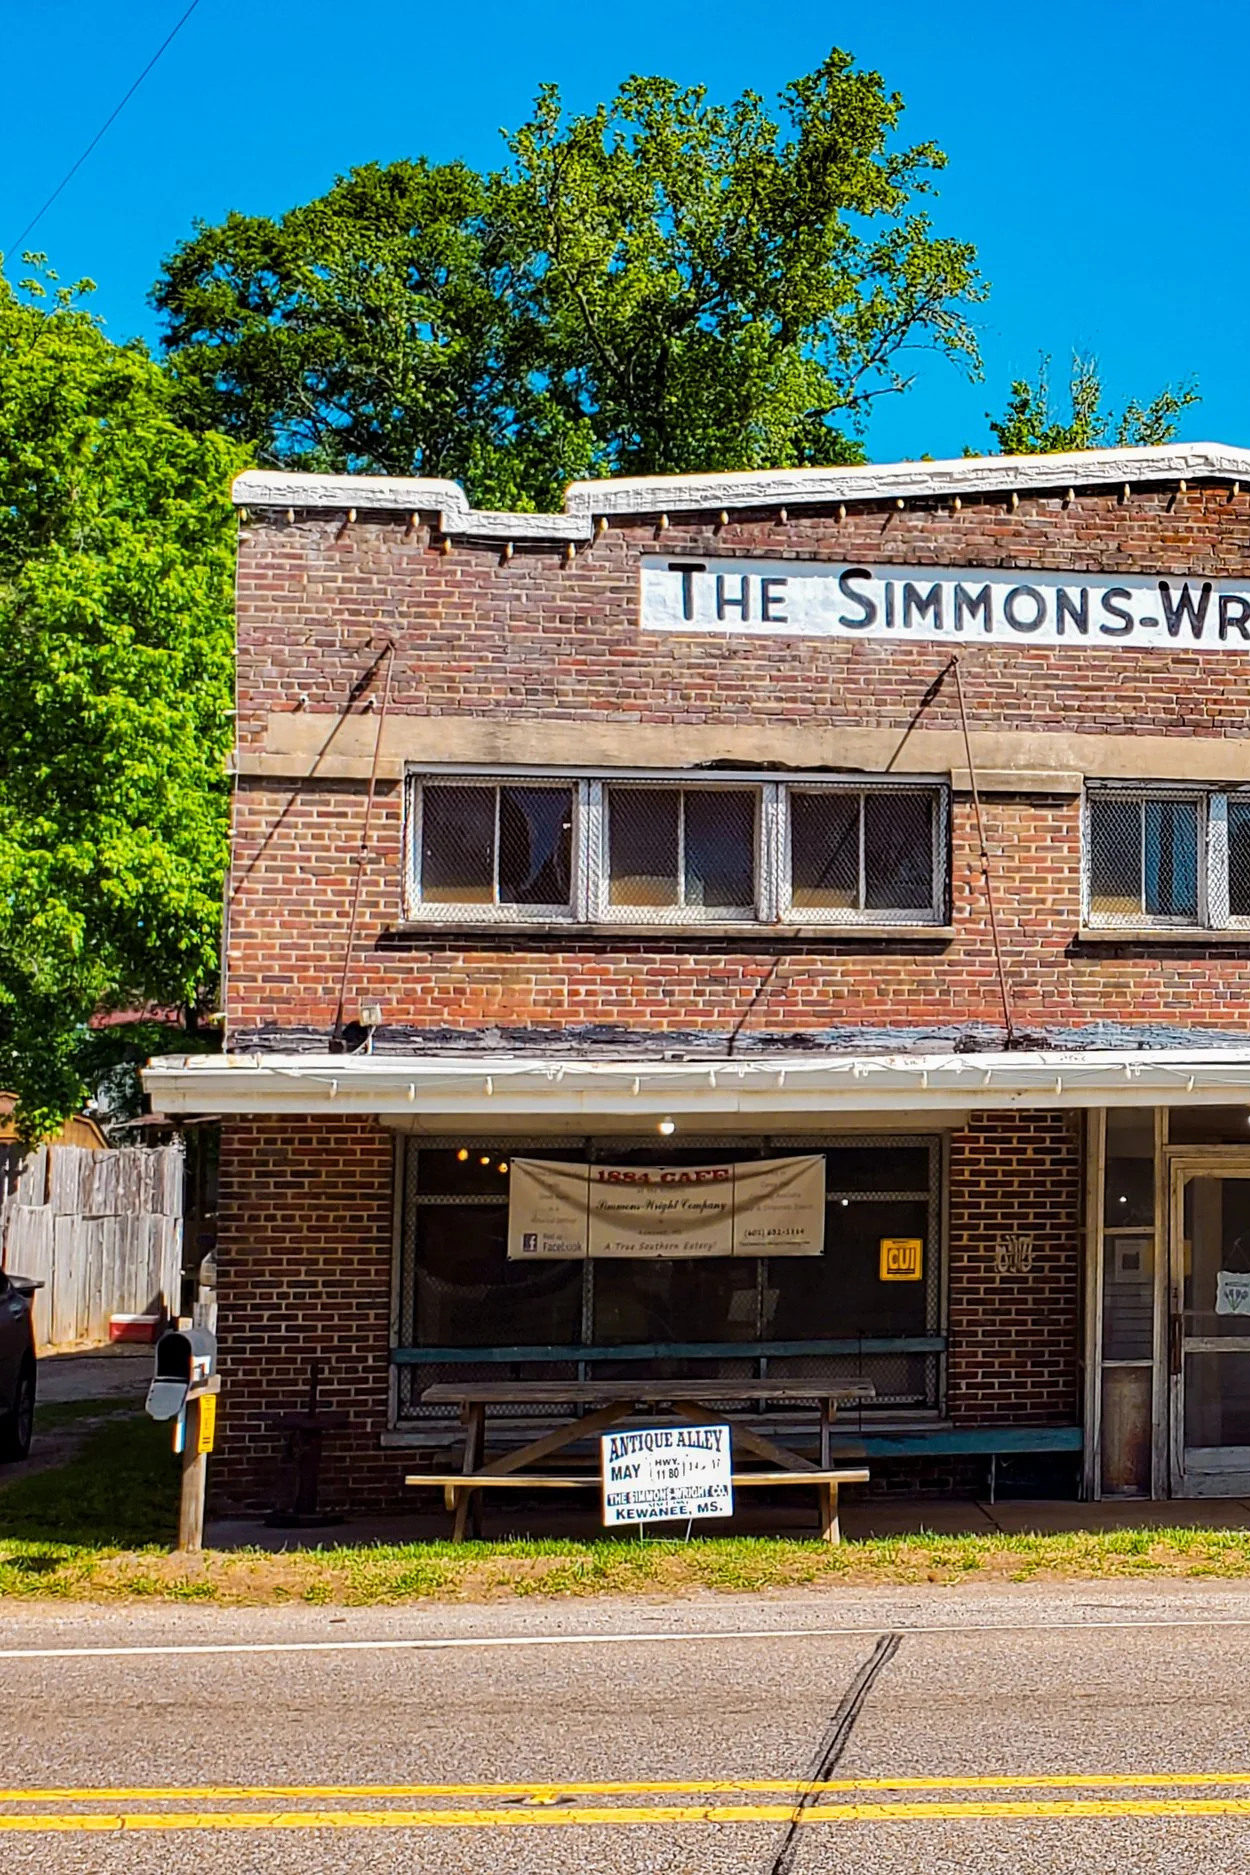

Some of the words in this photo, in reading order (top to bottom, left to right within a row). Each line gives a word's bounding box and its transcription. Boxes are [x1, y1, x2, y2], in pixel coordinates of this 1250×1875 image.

[668, 562, 789, 623] THE
[597, 1169, 651, 1184] 1884
[659, 1168, 730, 1184] CAFE
[639, 1241, 679, 1251] Southern
[609, 1431, 674, 1464] ANTIQUE
[676, 1428, 723, 1453] ALLEY
[611, 1463, 641, 1482] MAY
[608, 1493, 629, 1506] THE
[615, 1505, 693, 1520] KEWANEE,
[697, 1501, 723, 1514] MS.
